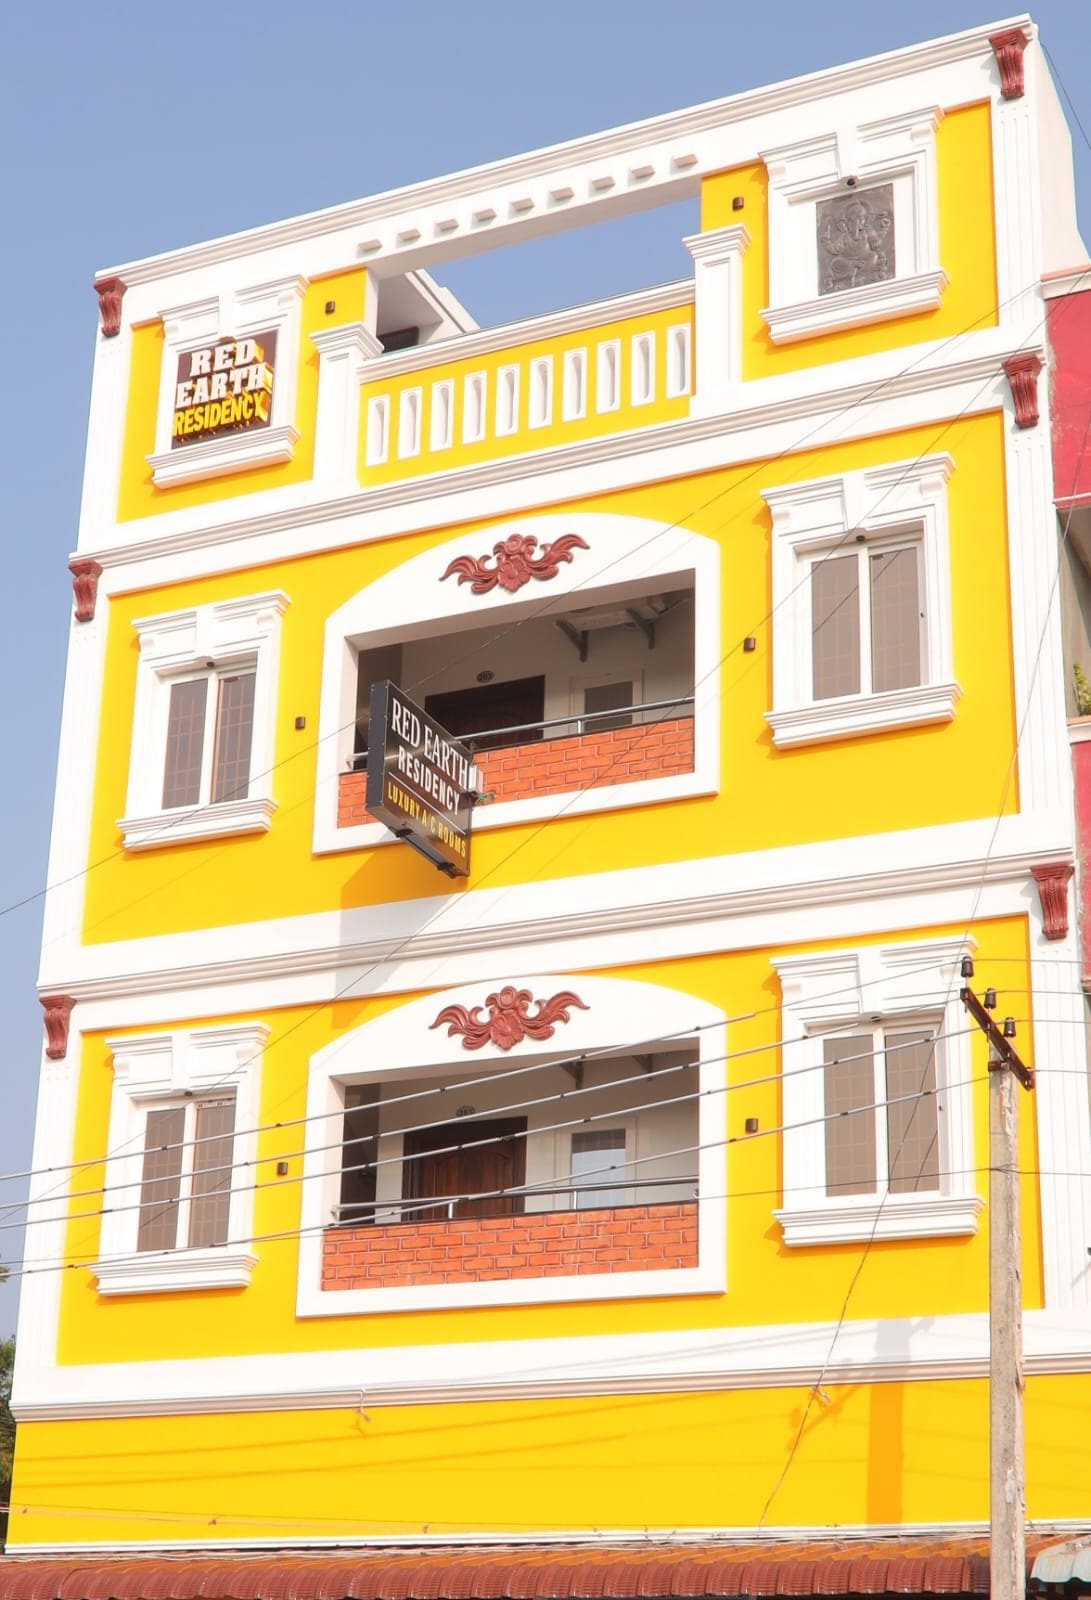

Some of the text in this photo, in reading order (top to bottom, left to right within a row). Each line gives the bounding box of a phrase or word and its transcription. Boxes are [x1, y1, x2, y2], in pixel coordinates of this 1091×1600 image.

[175, 362, 269, 409] EARTH
[190, 339, 259, 377] RED
[173, 391, 266, 437] RESIDENCY
[392, 697, 468, 791] RED EARTH
[398, 745, 460, 816] RESIDENCY
[388, 781, 420, 820] LUXURY
[438, 822, 466, 857] ROOMS
